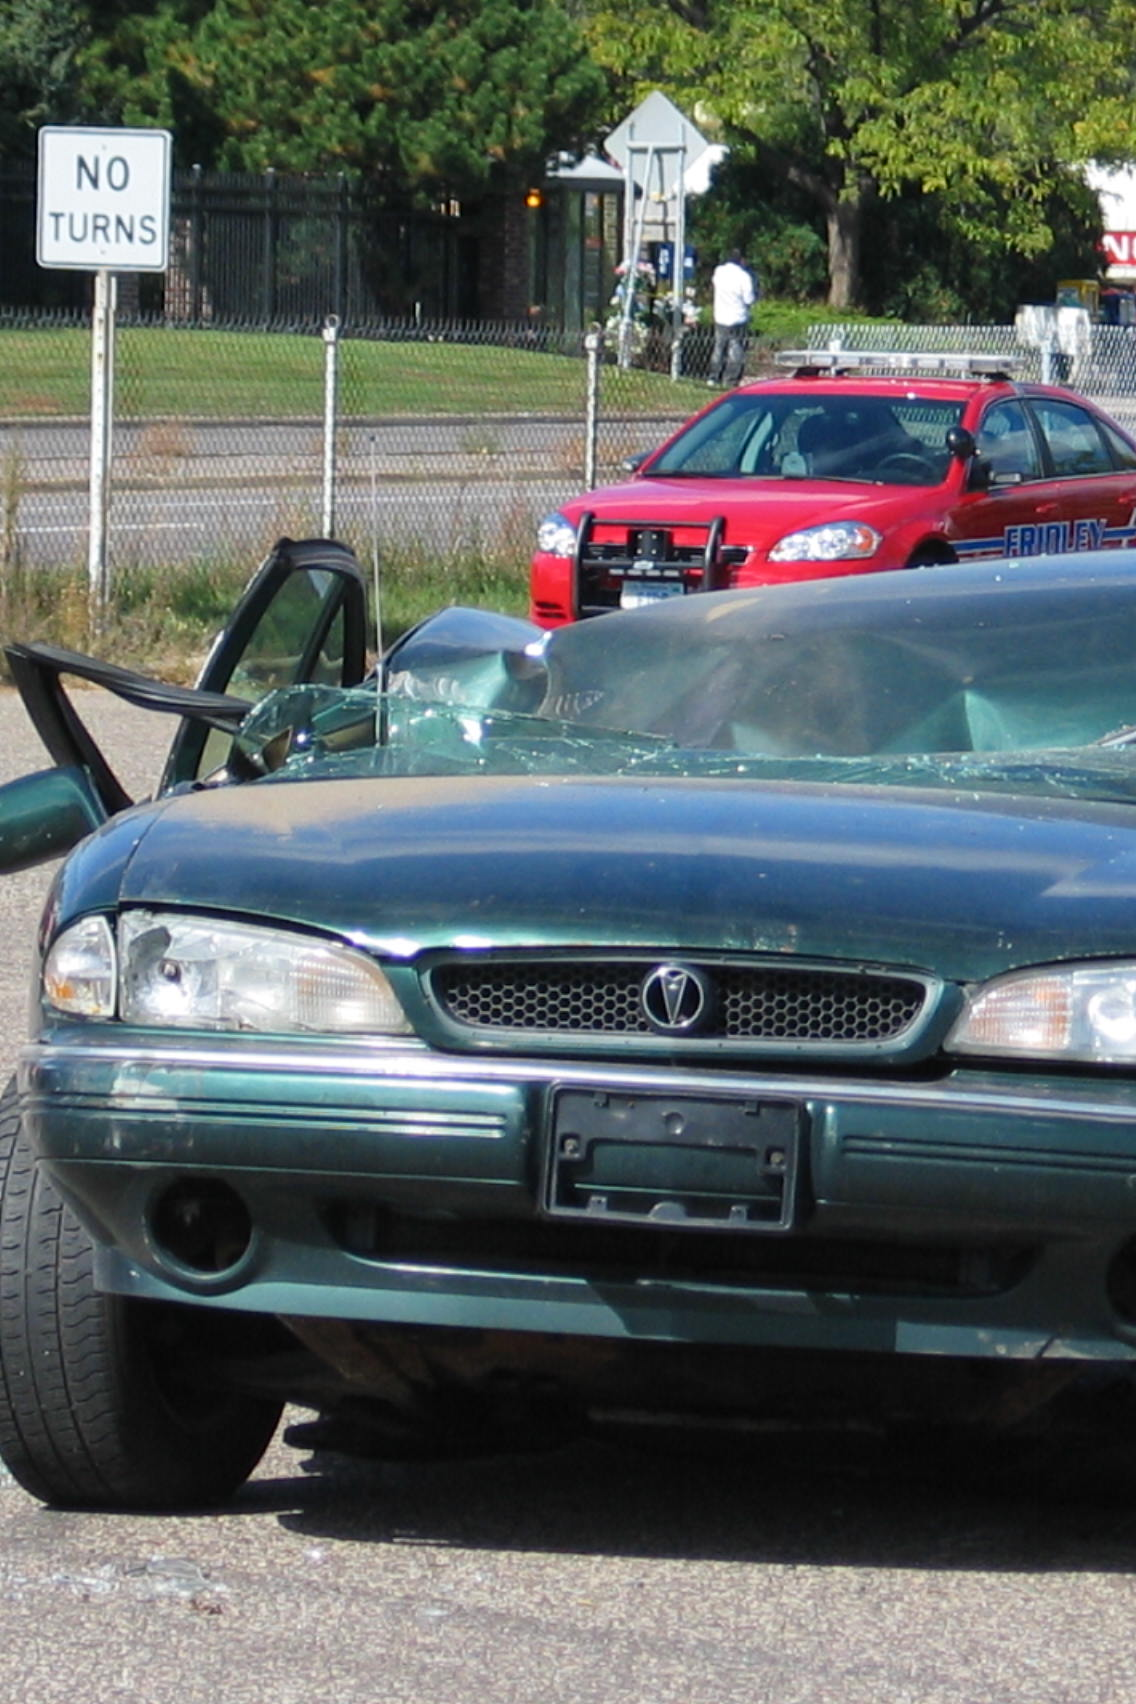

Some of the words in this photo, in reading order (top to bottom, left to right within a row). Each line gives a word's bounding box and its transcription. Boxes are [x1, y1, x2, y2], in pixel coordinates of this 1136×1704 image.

[76, 155, 130, 192] NO
[49, 212, 157, 245] TURNS
[1004, 518, 1107, 557] FRIDLEY
